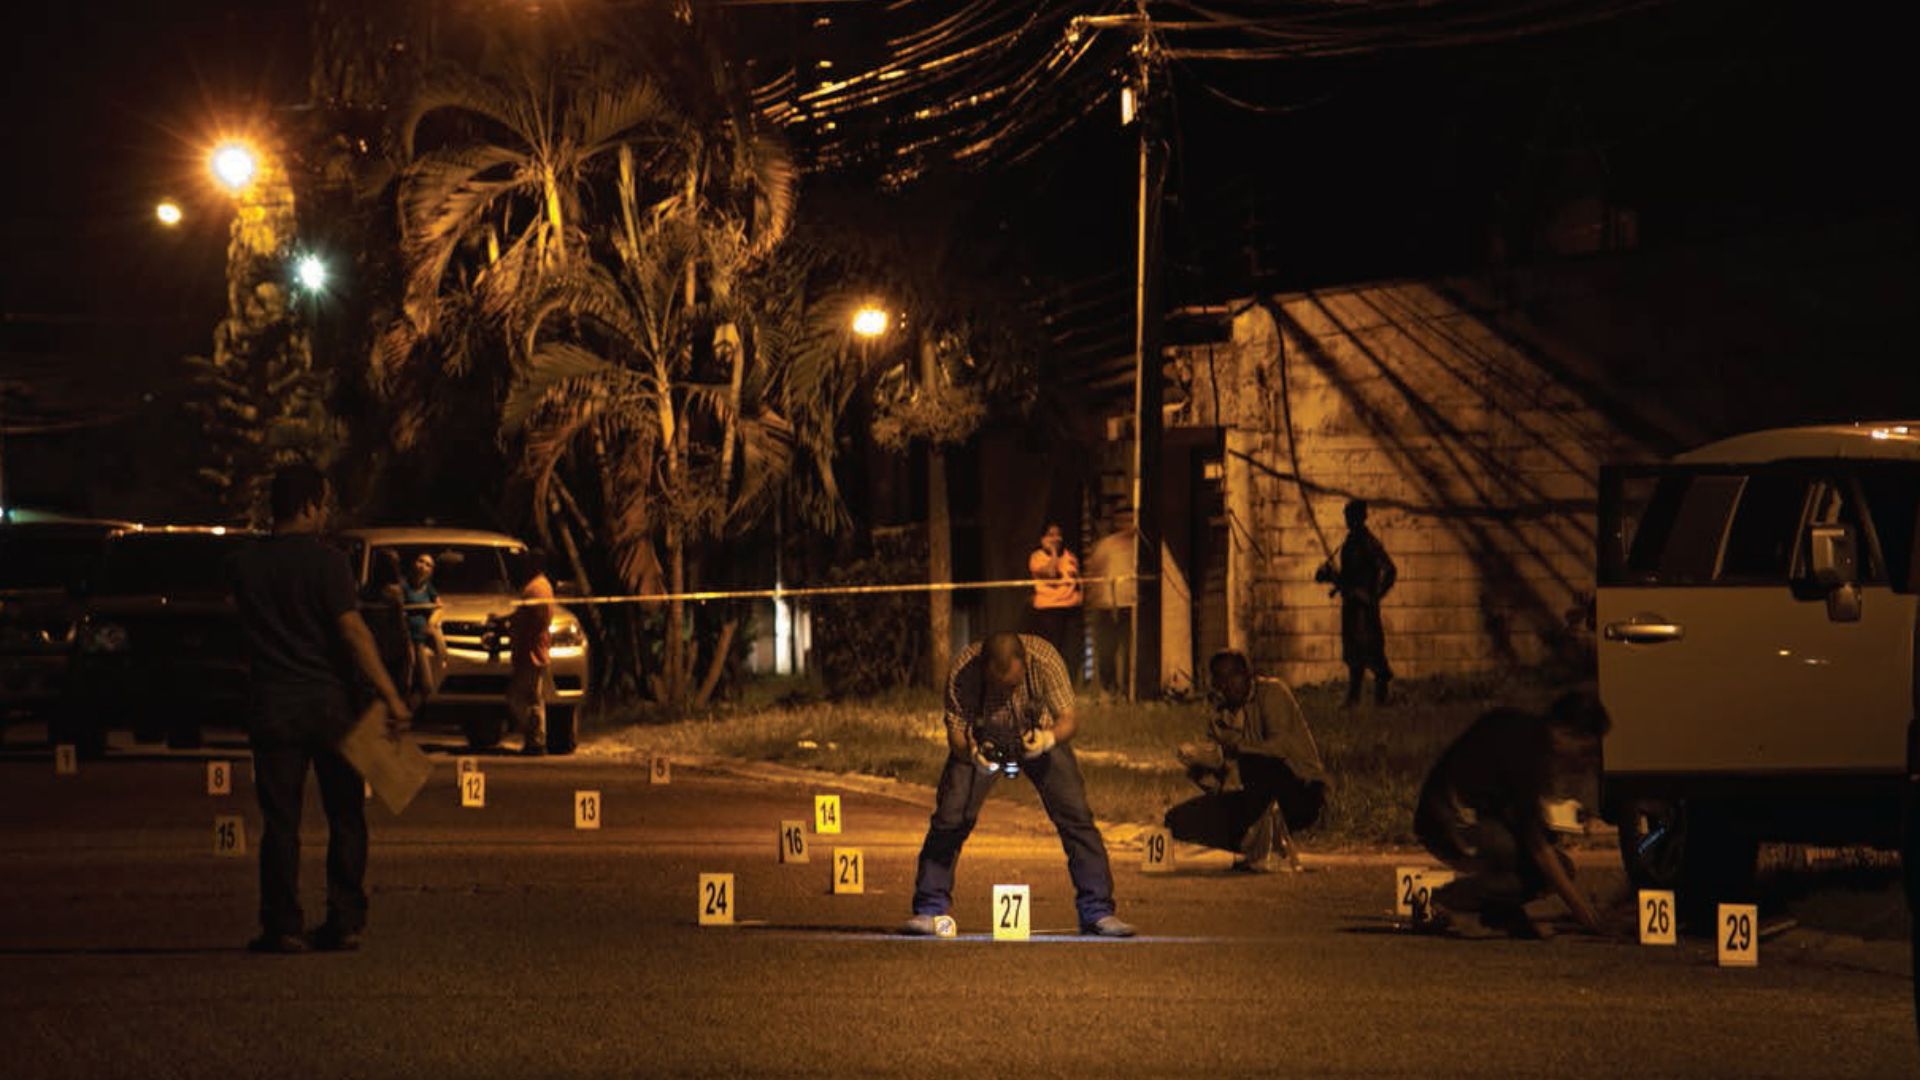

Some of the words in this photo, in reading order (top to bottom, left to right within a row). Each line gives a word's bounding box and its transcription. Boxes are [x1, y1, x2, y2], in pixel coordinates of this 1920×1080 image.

[214, 767, 224, 789] 8
[656, 758, 665, 778] 5
[466, 777, 481, 800] 12
[581, 797, 596, 821] 13
[821, 801, 836, 826] 14
[218, 822, 235, 849] 15
[785, 827, 803, 855] 16
[1148, 833, 1164, 863] 19
[839, 855, 859, 885] 21
[705, 881, 727, 915] 24
[1000, 895, 1023, 929] 27
[1646, 899, 1669, 933] 26
[1726, 914, 1750, 950] 29
